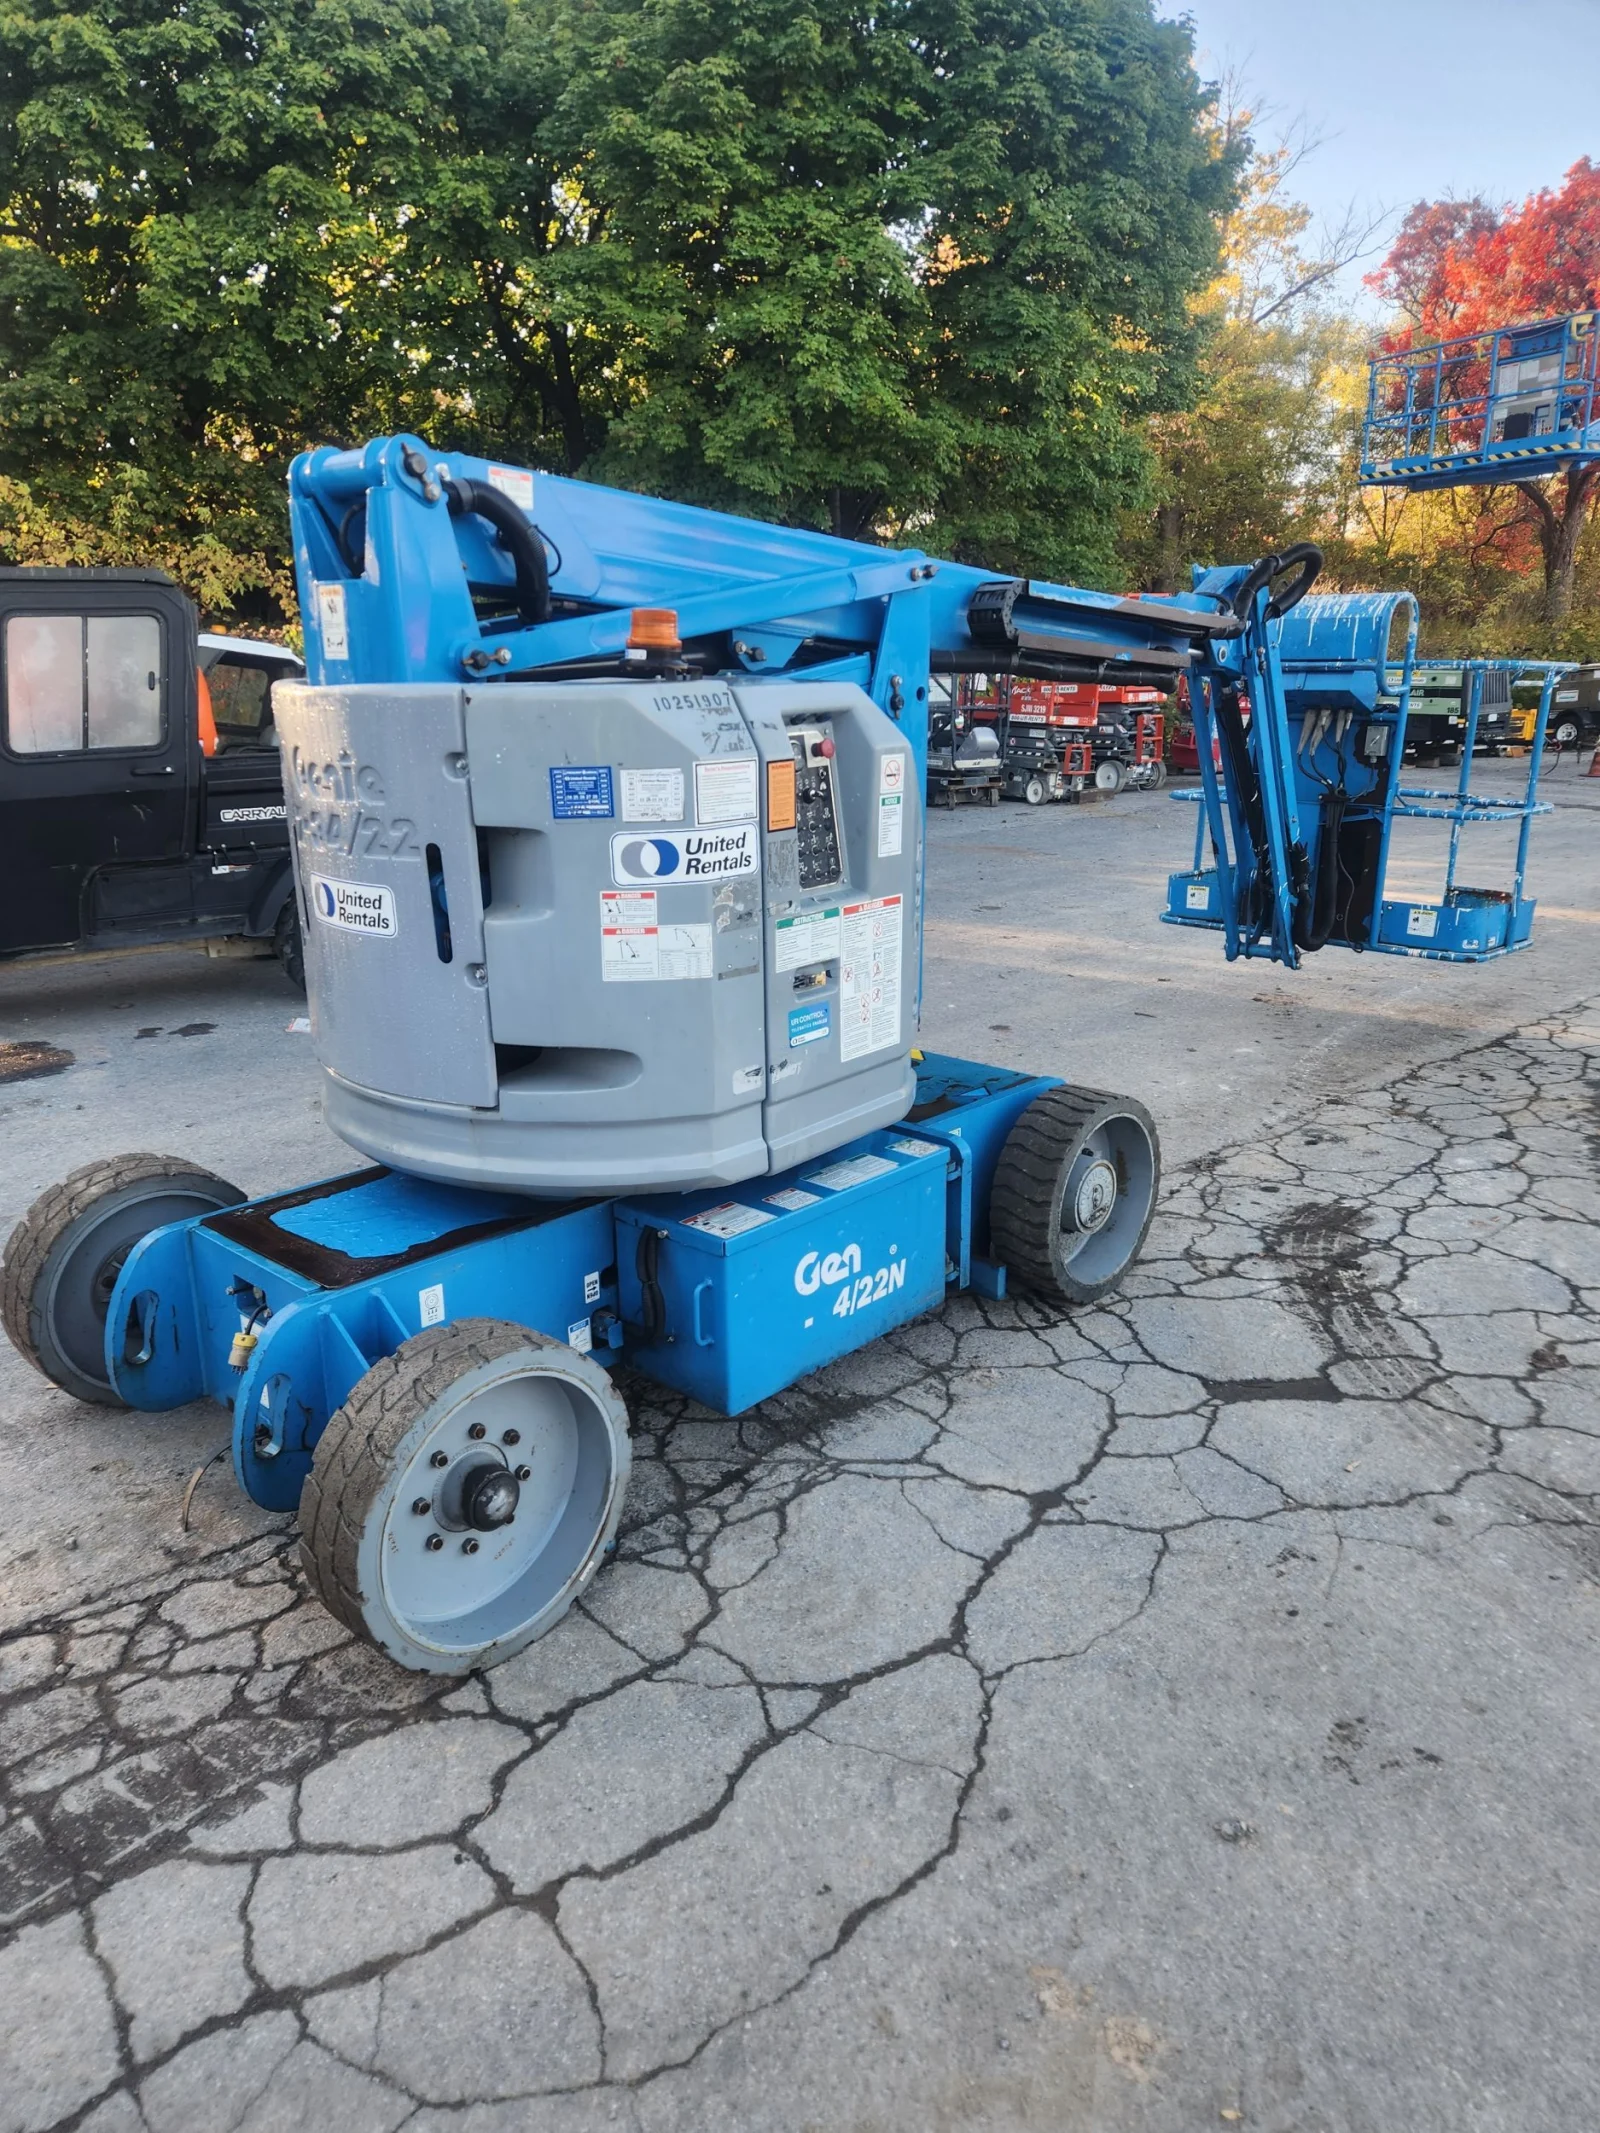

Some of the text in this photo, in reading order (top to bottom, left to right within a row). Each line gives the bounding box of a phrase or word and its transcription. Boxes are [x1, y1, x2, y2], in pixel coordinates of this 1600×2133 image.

[653, 692, 731, 711] 10251907
[1033, 705, 1046, 713] 3219
[220, 806, 288, 822] CARRYAL
[685, 832, 746, 855] United
[685, 851, 752, 875] Rentals
[336, 888, 382, 910] United
[339, 907, 390, 929] Rentals
[832, 1258, 907, 1318] 4/22N
